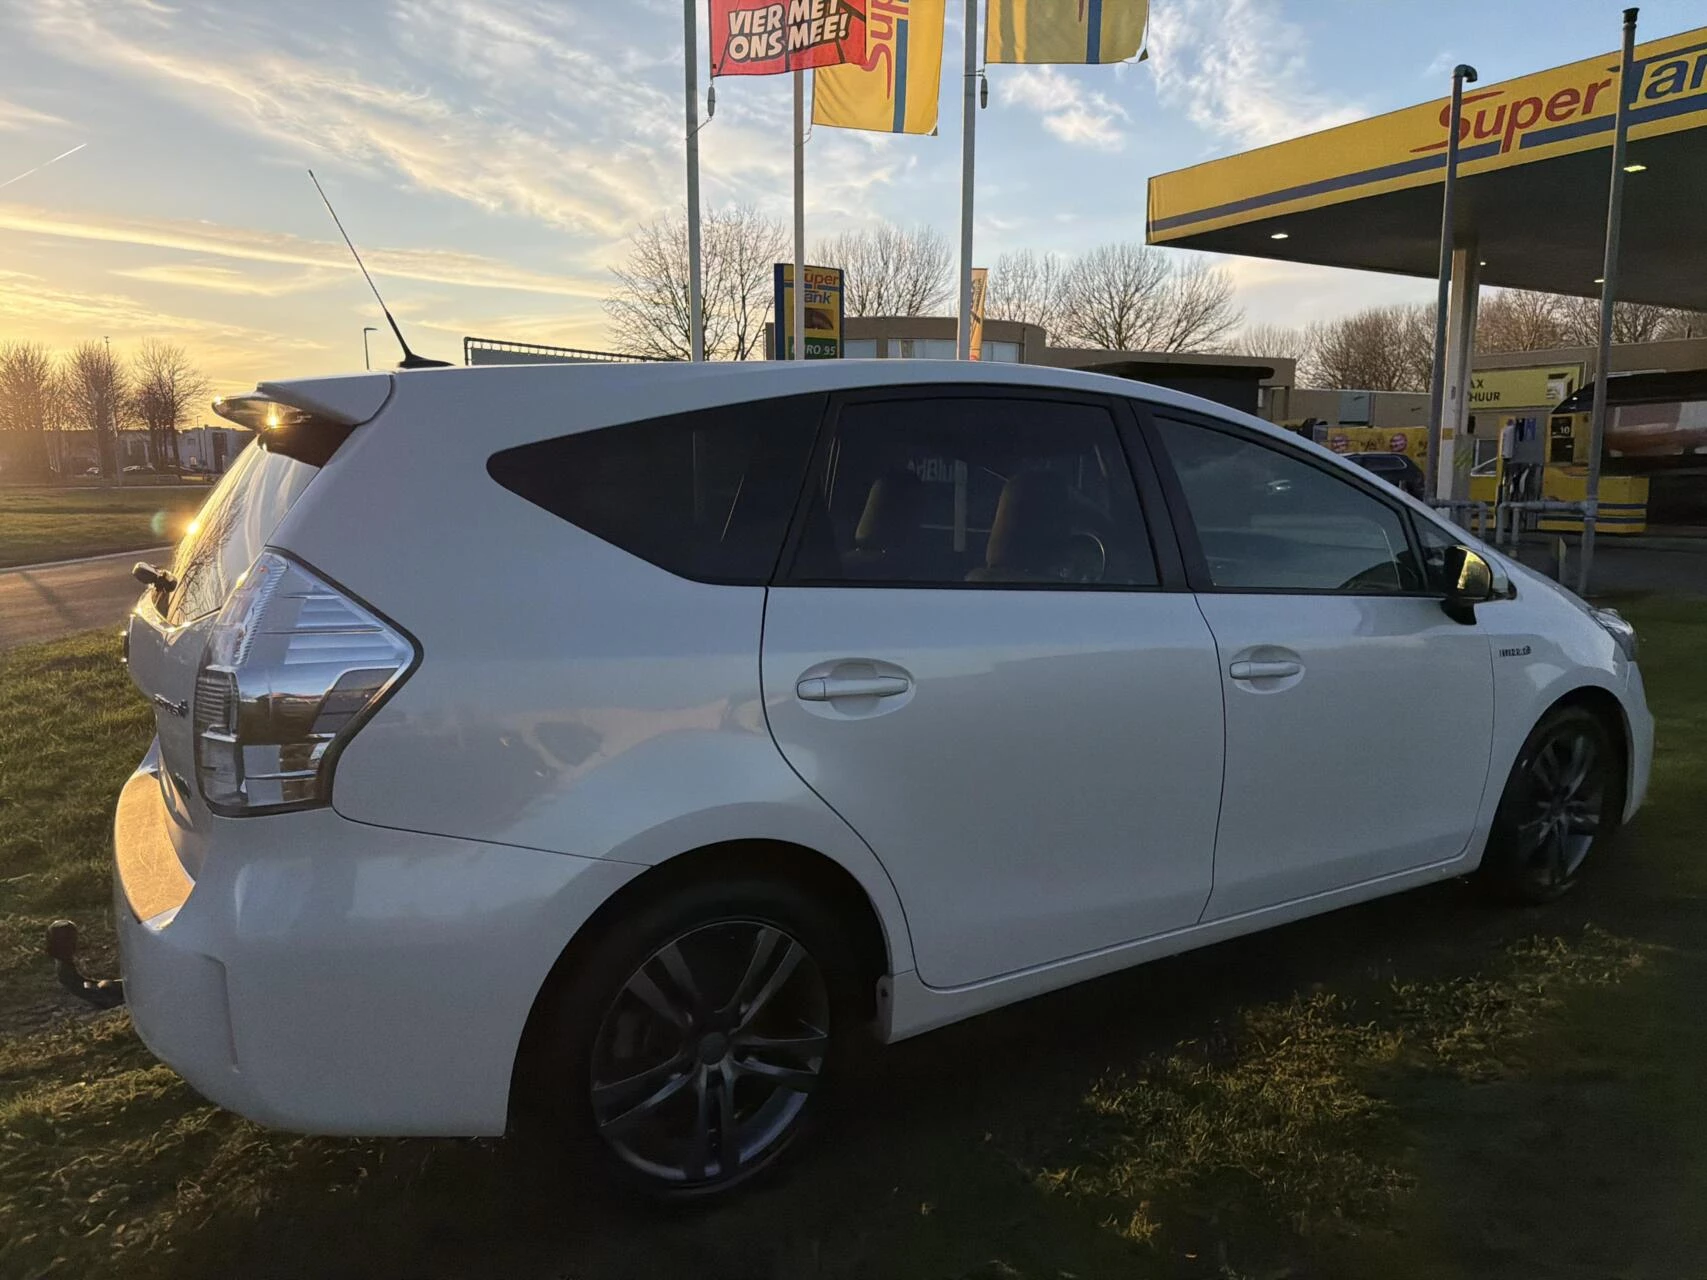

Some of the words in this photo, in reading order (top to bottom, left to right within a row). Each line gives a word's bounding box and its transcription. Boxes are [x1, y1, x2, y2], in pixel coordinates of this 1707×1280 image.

[729, 4, 783, 35] VIER
[729, 30, 782, 60] ONS
[788, 13, 848, 50] MEE!
[1409, 78, 1612, 154] Super
[802, 270, 839, 290] uper
[803, 289, 831, 304] ank
[823, 346, 836, 356] 95
[1467, 391, 1500, 402] HUUR
